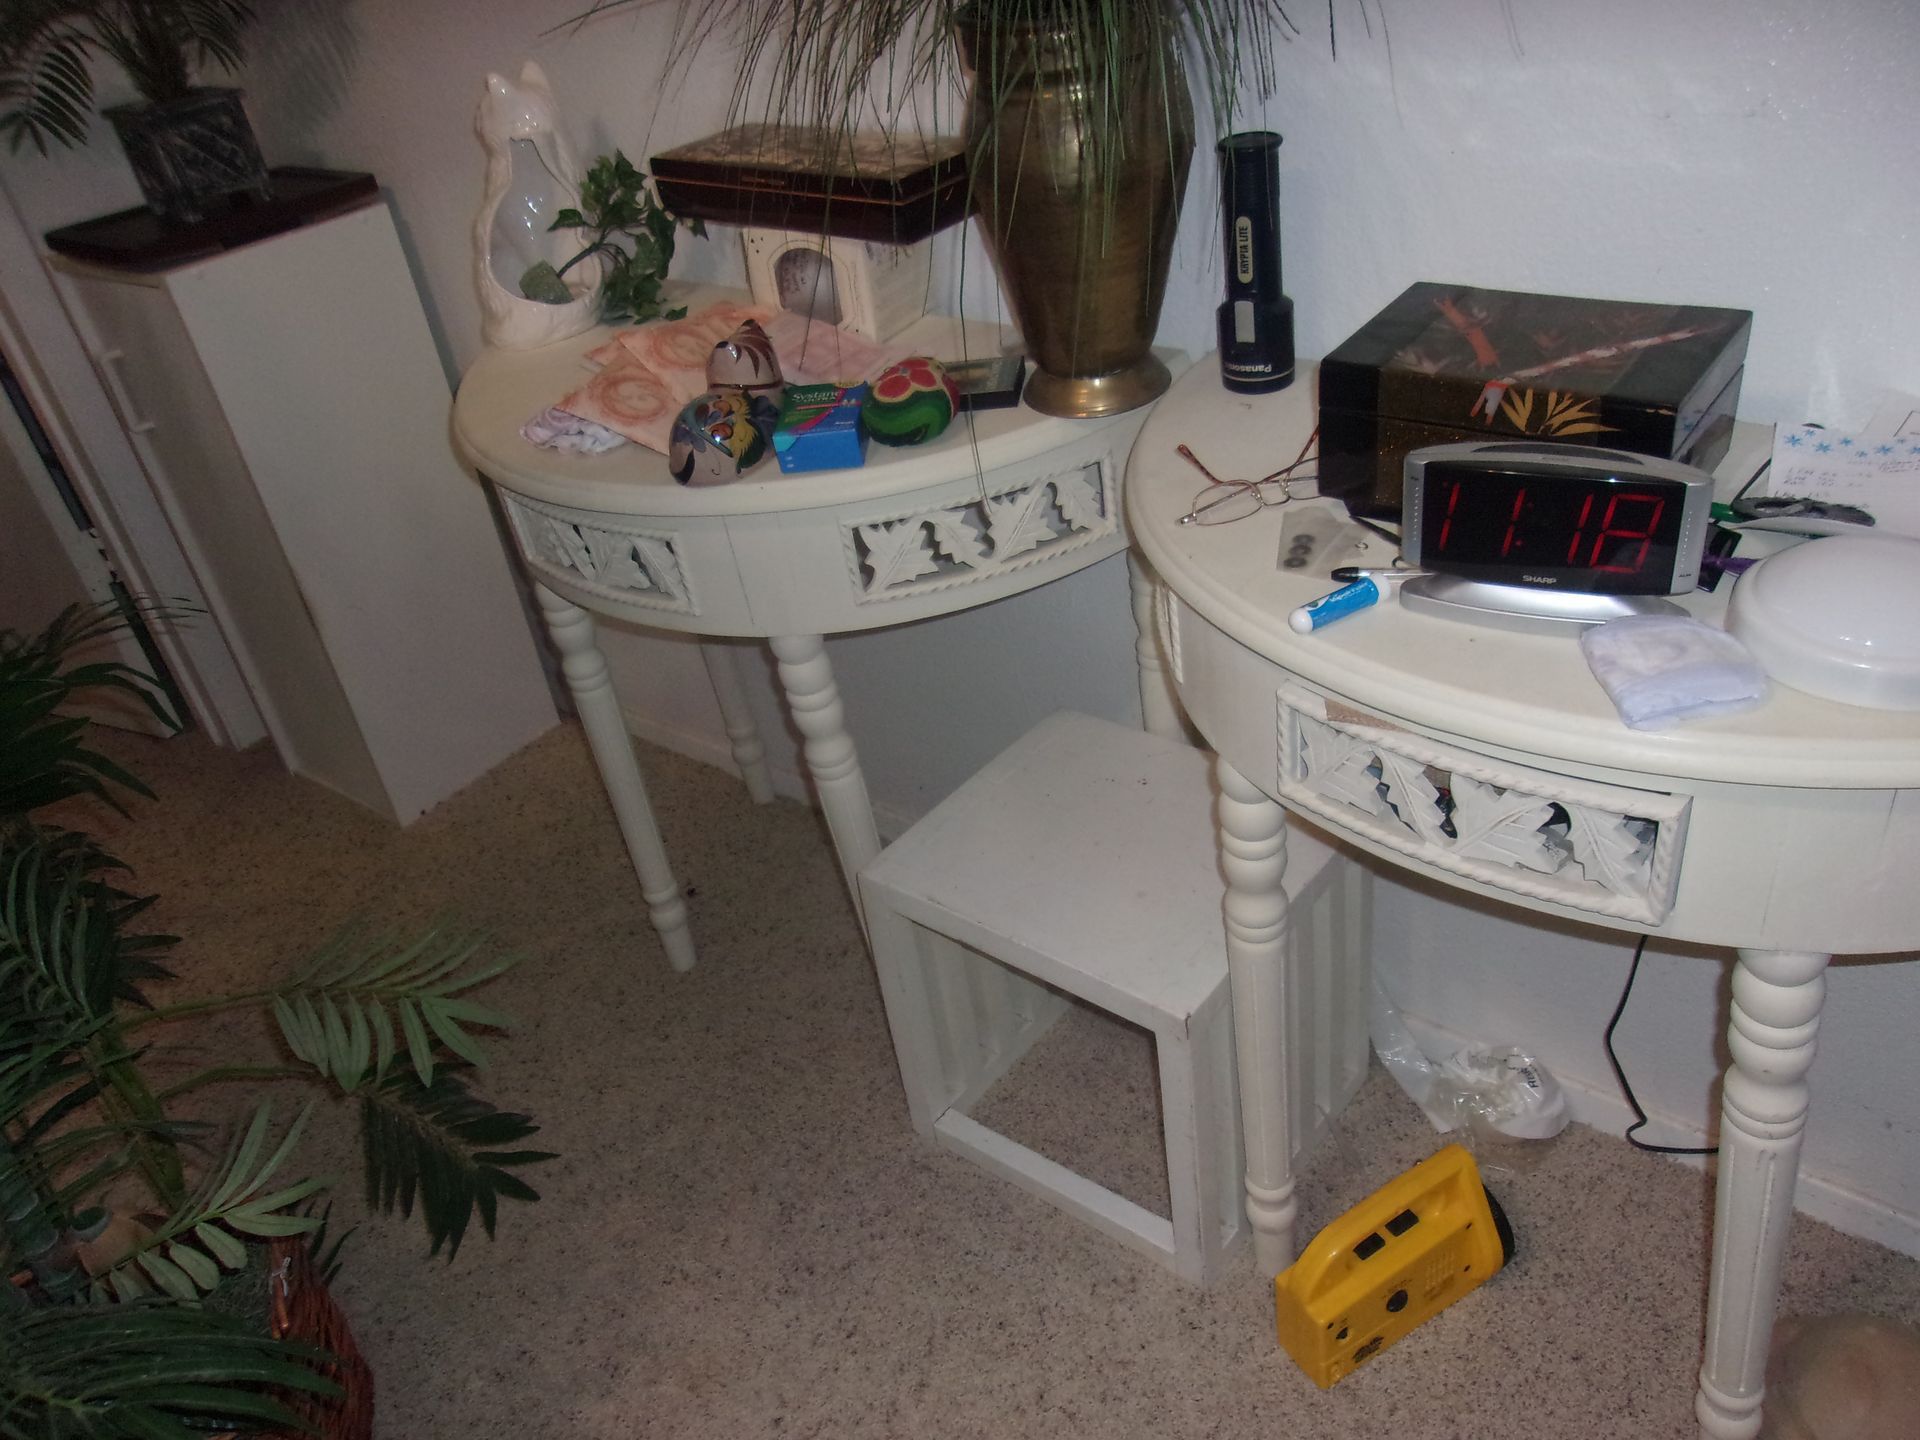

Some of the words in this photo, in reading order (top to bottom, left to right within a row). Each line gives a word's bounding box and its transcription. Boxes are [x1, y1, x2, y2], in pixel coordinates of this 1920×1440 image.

[1239, 225, 1249, 242] LITE
[1226, 363, 1273, 373] Panason
[1439, 482, 1665, 574] 11:18
[1522, 574, 1557, 584] SHARP
